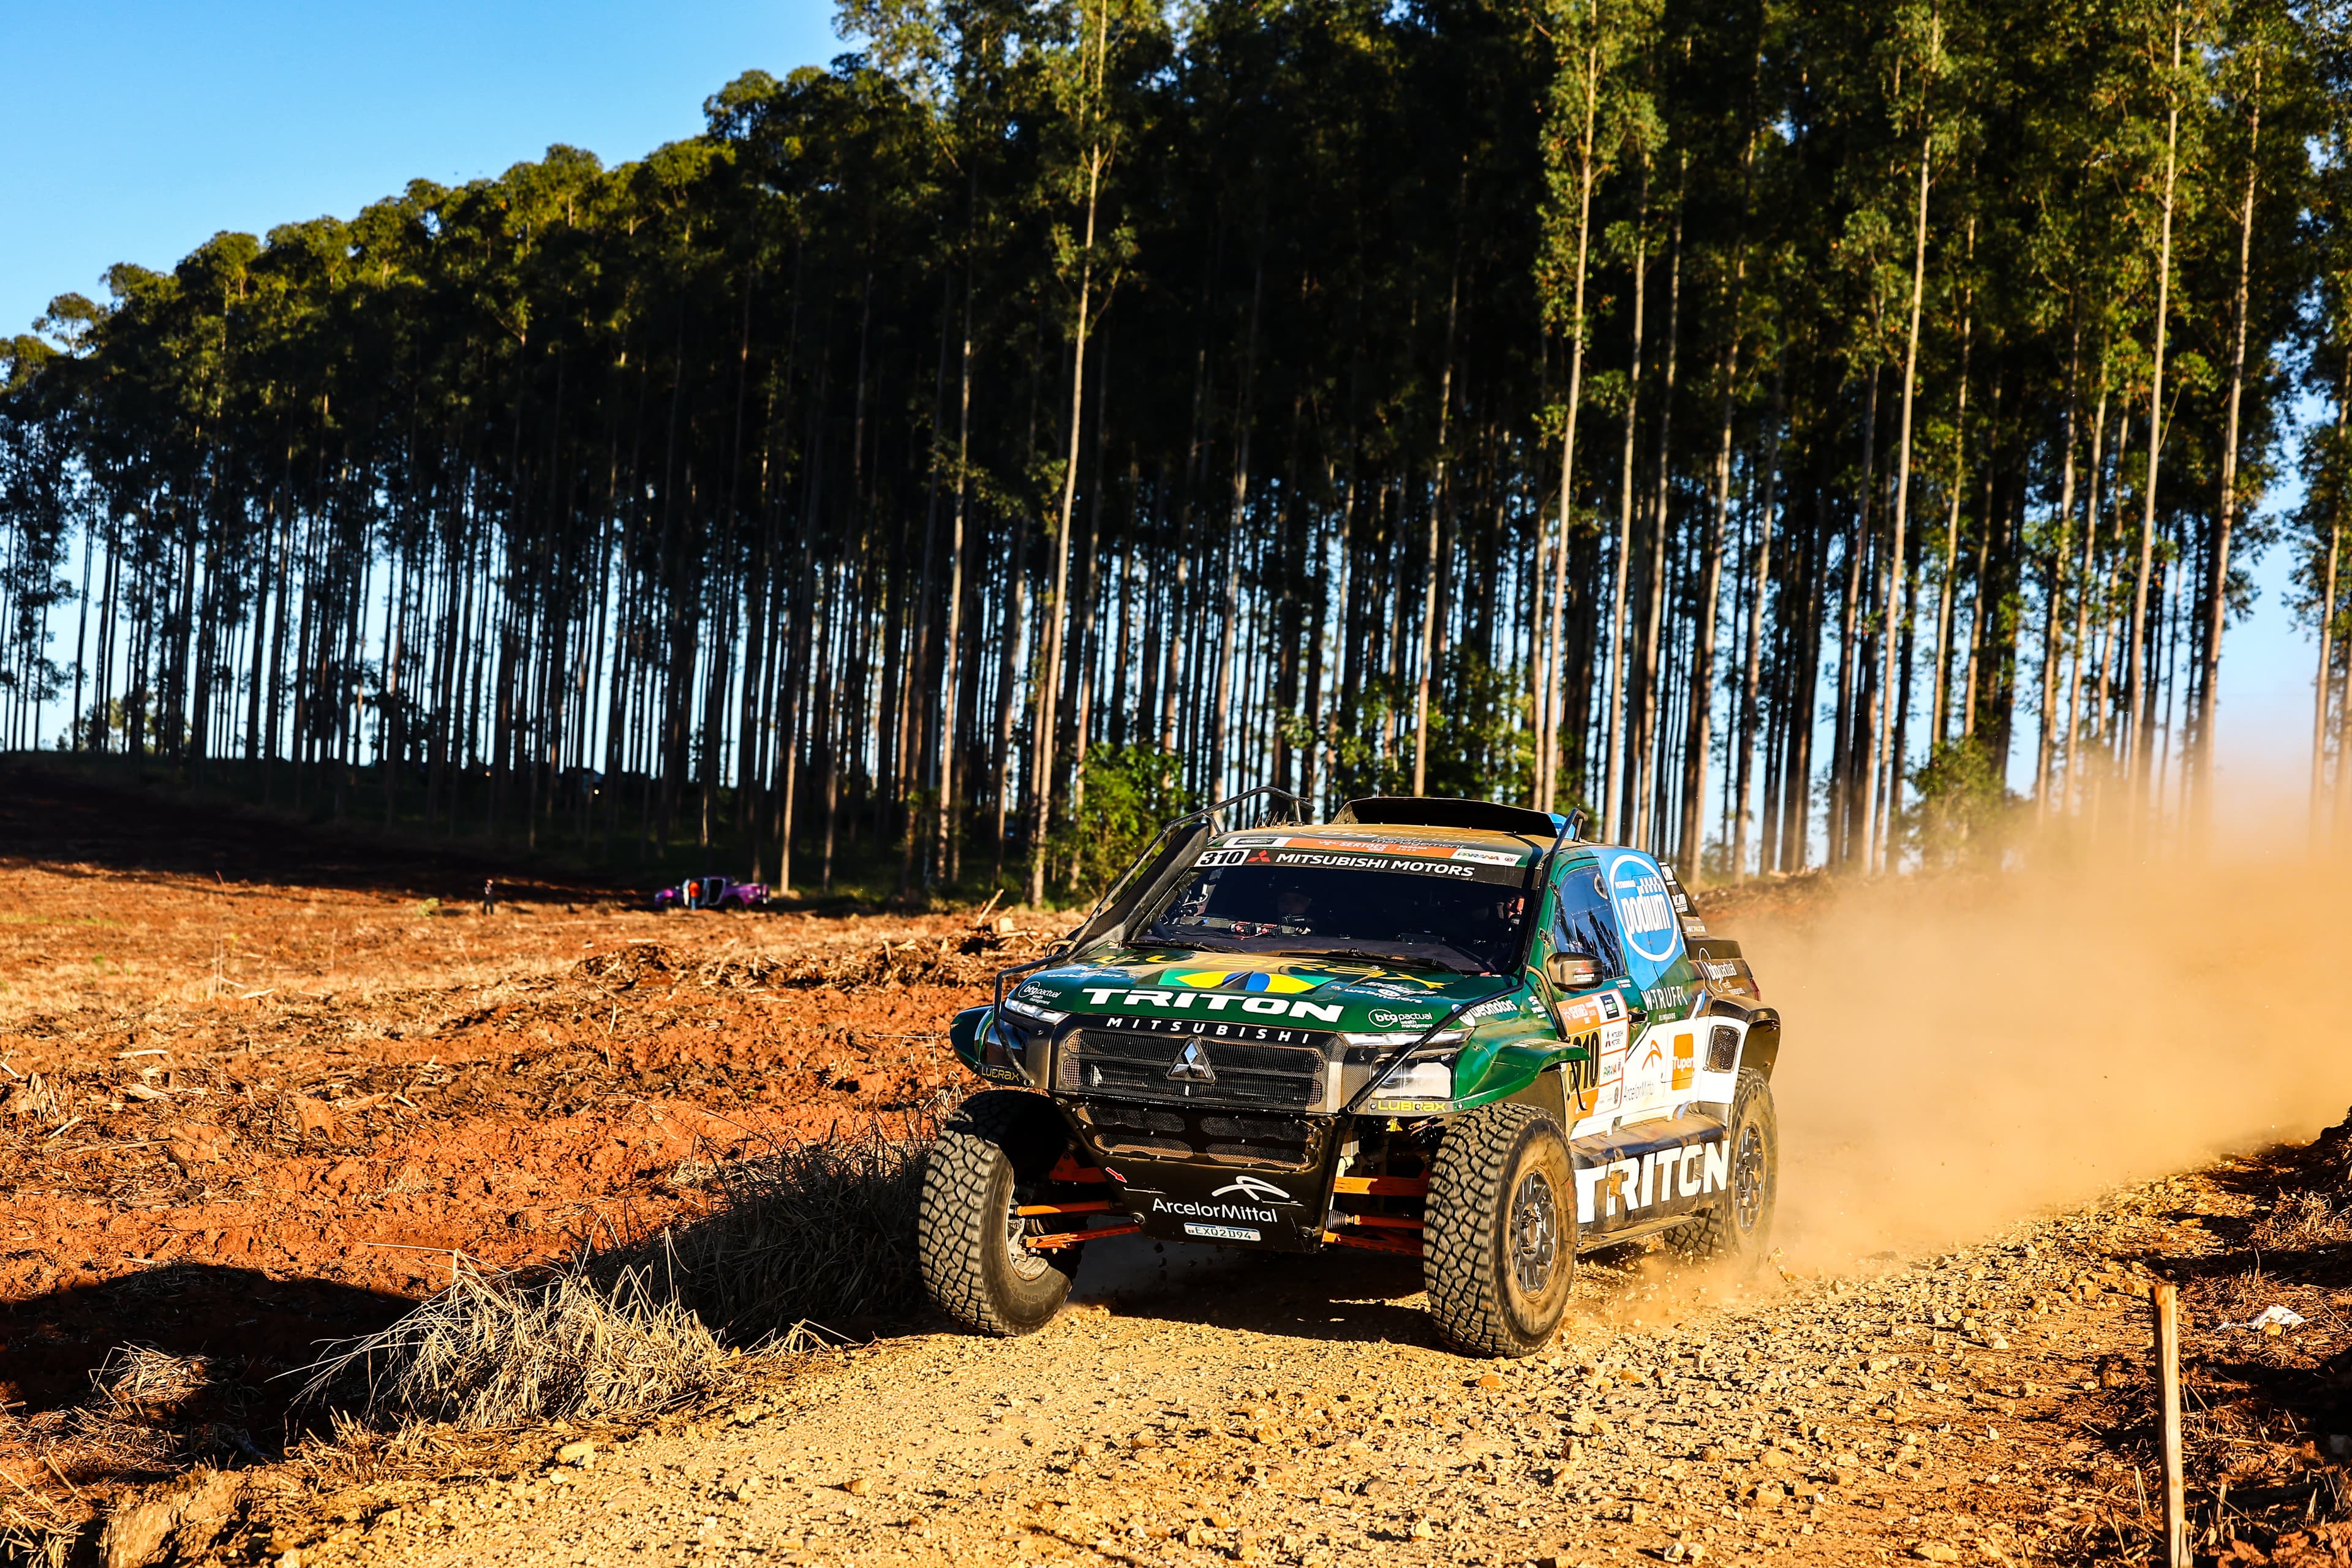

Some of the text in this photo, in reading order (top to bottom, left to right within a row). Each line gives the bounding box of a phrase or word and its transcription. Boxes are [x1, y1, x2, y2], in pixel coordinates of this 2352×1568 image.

[1200, 851, 1241, 865] 310
[1275, 853, 1476, 876] MITSUBISHI MOTORS
[1620, 886, 1672, 935] podium
[1023, 985, 1062, 999] btg pactual
[1082, 988, 1344, 1023] TRITON
[1106, 1017, 1310, 1044] MITSUBISHI
[1375, 1011, 1433, 1027] btg pactual
[1672, 1055, 1694, 1073] Tuper
[1574, 1139, 1730, 1224] TRITON
[1152, 1197, 1278, 1223] ArcelorMittal
[1195, 1226, 1252, 1240] EXQ2D94
